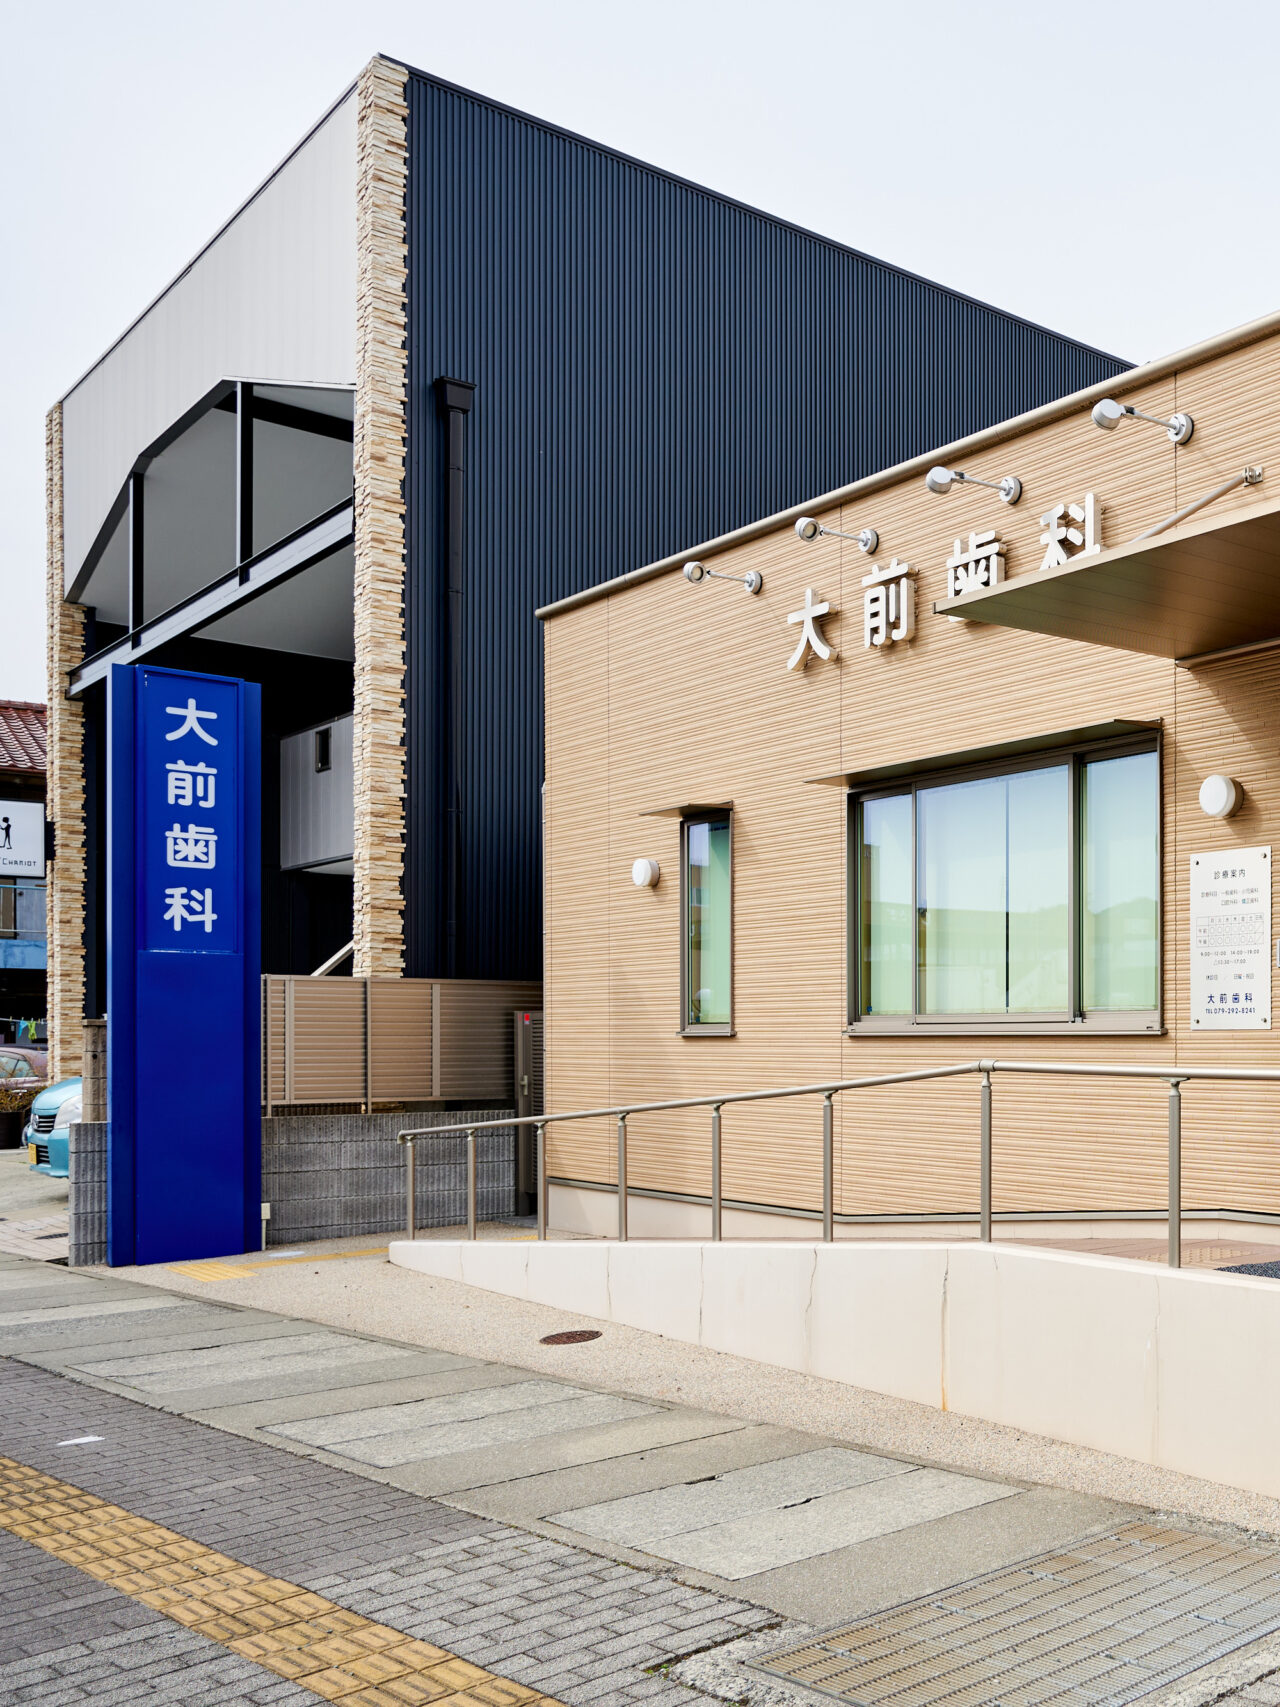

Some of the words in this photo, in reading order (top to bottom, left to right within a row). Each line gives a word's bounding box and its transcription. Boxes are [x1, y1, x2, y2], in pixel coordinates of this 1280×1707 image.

[787, 492, 1104, 672] 大前歯科
[163, 697, 218, 934] 大前歯科
[1207, 993, 1253, 1004] 大前歯科
